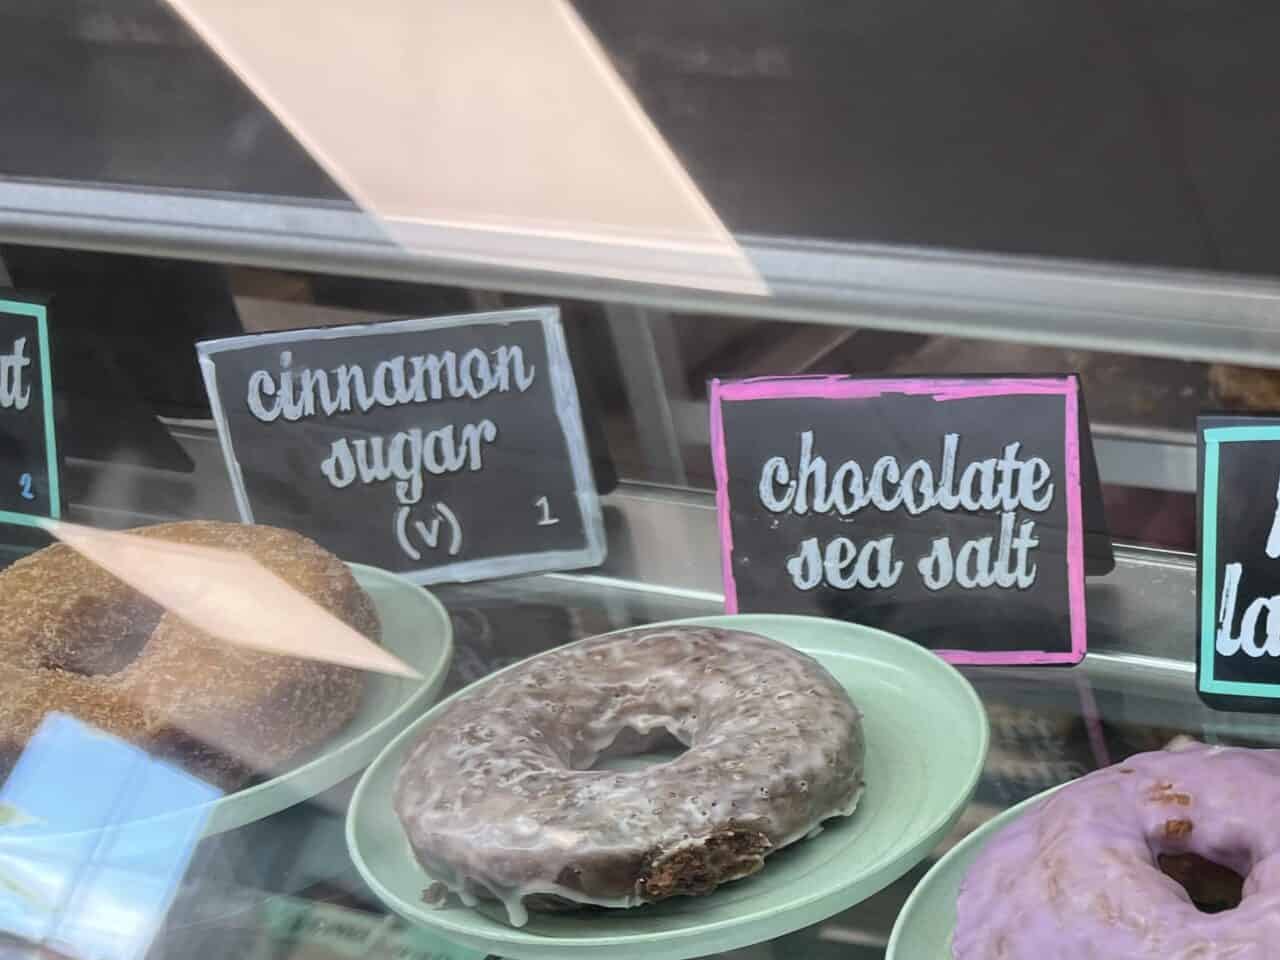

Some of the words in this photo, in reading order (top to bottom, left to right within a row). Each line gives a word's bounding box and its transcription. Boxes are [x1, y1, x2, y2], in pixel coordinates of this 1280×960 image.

[247, 344, 535, 422] cinnamon
[18, 472, 36, 500] 2
[321, 418, 498, 503] sugar
[758, 430, 1054, 516] chocolate
[396, 502, 462, 560] (v)
[534, 495, 560, 527] 1
[786, 536, 904, 591] sea
[917, 511, 1040, 591] salt
